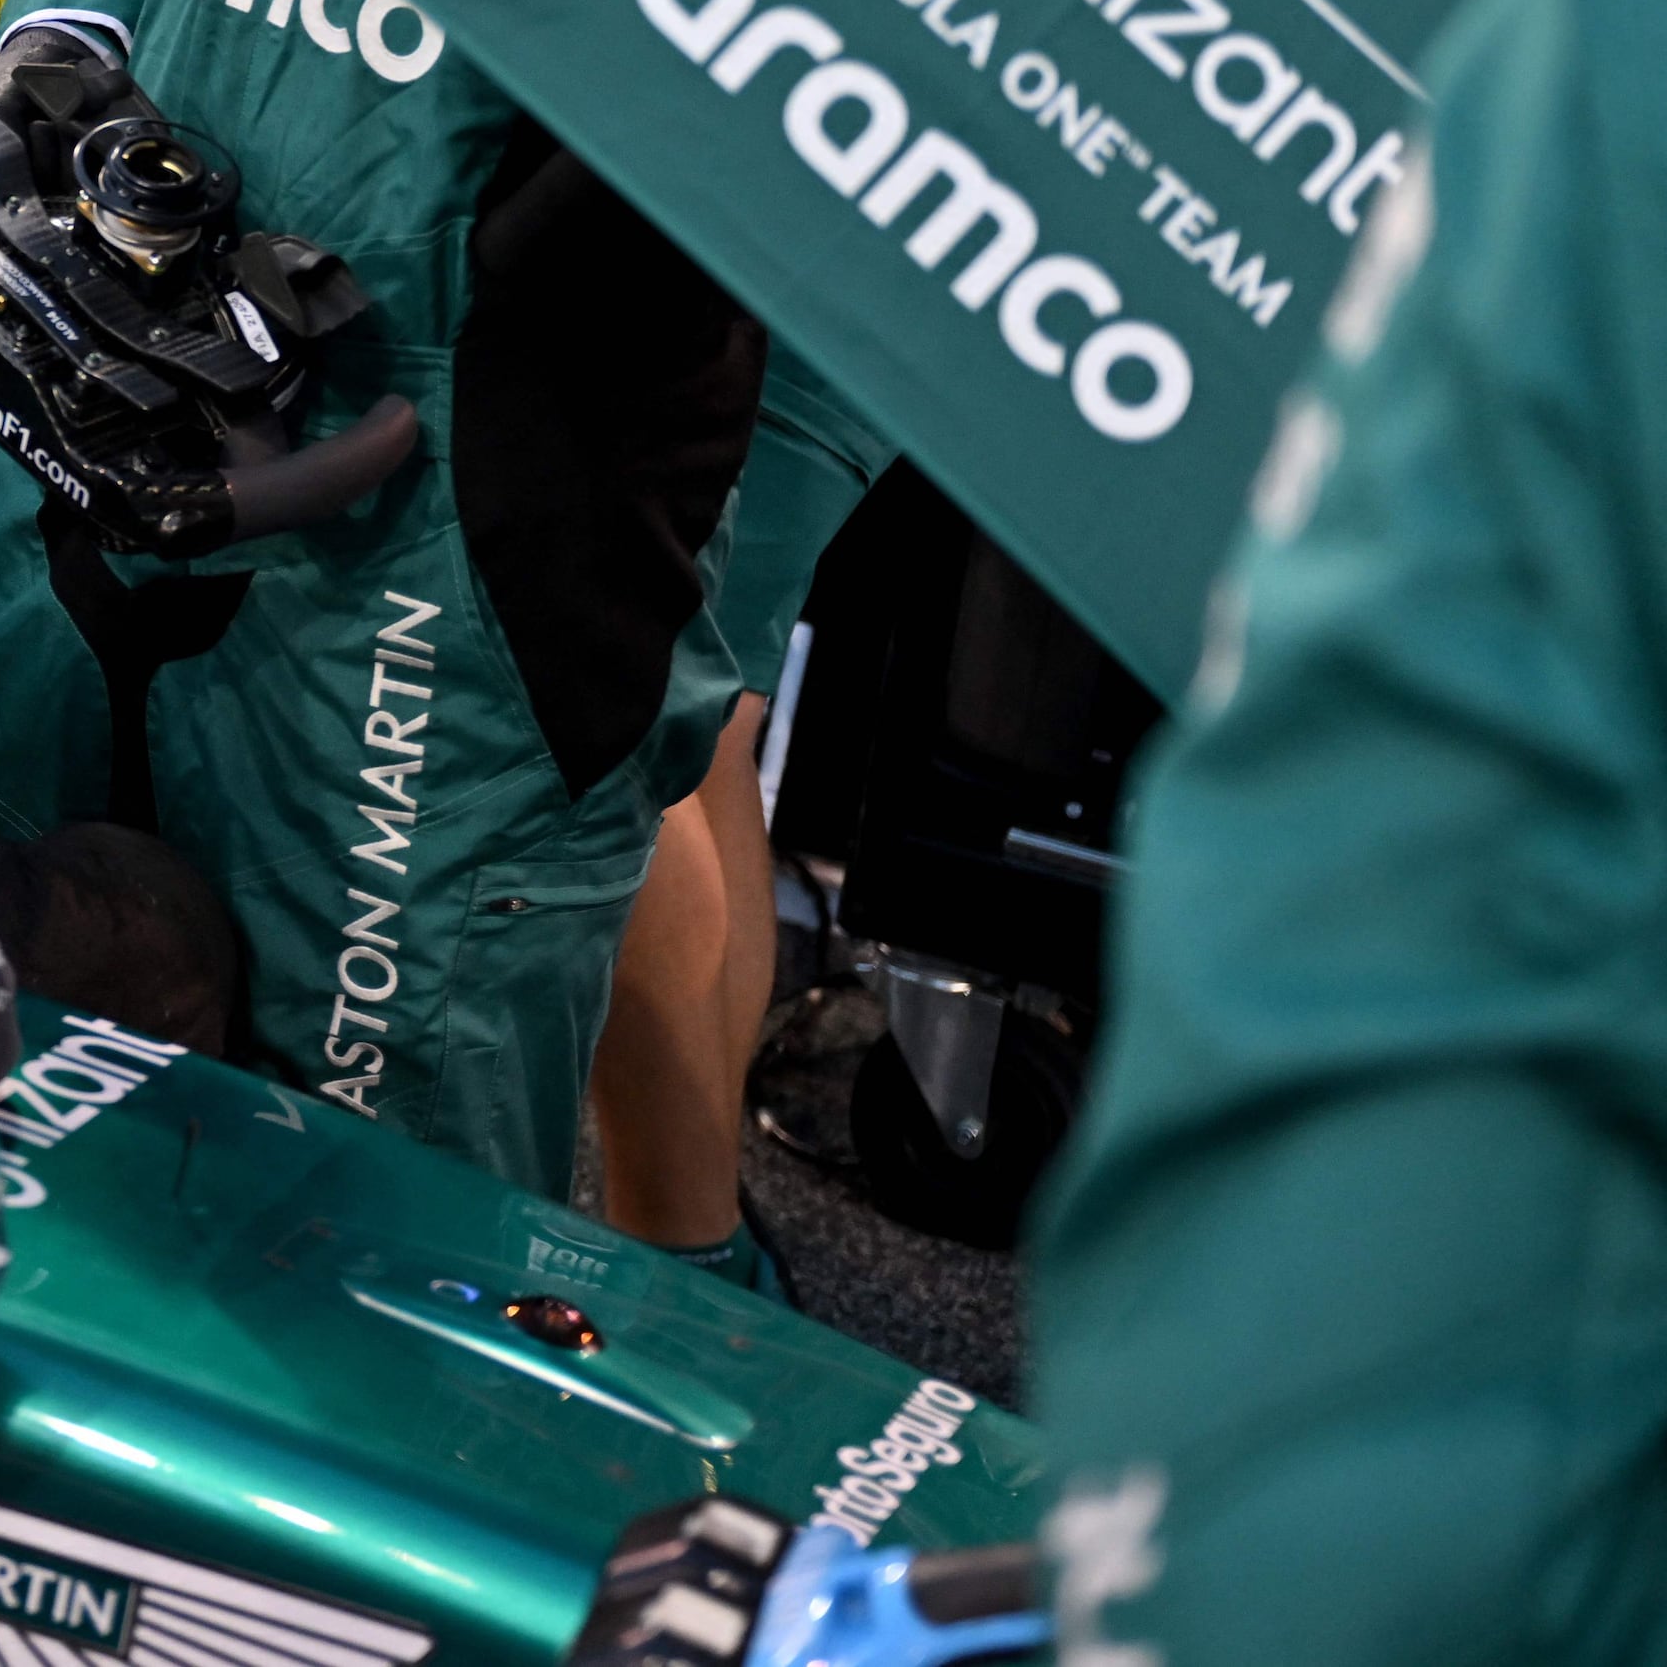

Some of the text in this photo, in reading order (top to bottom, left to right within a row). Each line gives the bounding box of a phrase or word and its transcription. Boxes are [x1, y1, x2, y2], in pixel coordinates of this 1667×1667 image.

[1136, 164, 1295, 330] TEAM
[319, 590, 442, 1119] ASTON MARTIN
